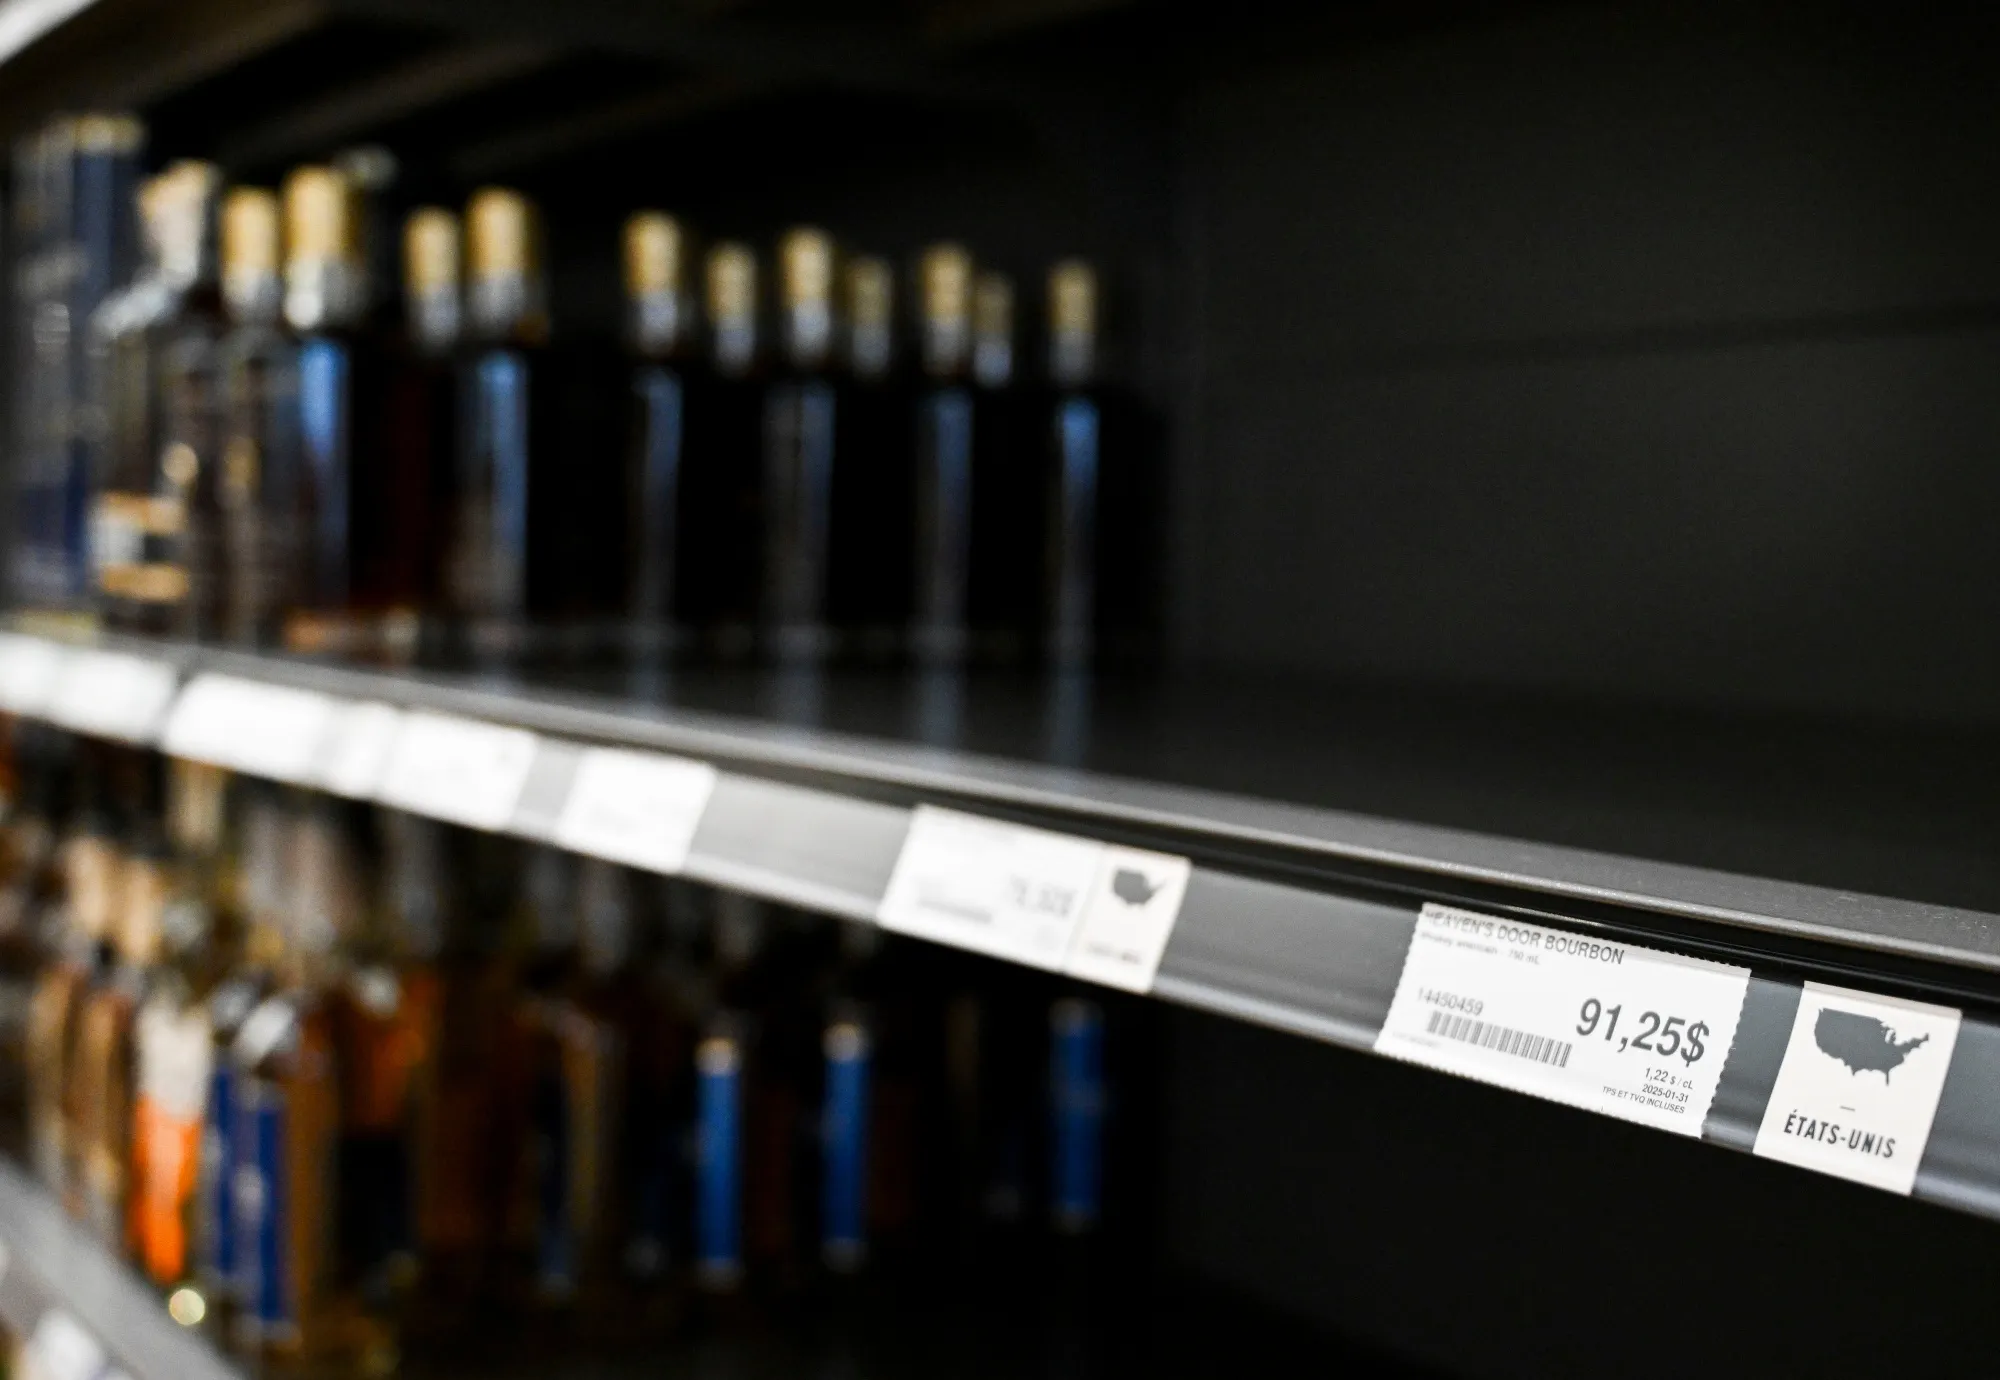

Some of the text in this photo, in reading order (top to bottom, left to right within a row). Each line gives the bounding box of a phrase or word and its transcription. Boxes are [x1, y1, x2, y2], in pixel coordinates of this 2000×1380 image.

[1497, 925, 1541, 948] DOOR
[1545, 935, 1626, 965] BOURBON
[1418, 987, 1484, 1016] 14450459
[1576, 998, 1710, 1067] 91,25$
[1645, 1067, 1669, 1082] 1,22
[1602, 1086, 1685, 1114] TPS ET TVQ INCLUSES
[1642, 1084, 1689, 1103] 2025-01-31
[1783, 1109, 1896, 1158] ÉTATS-UNIS
